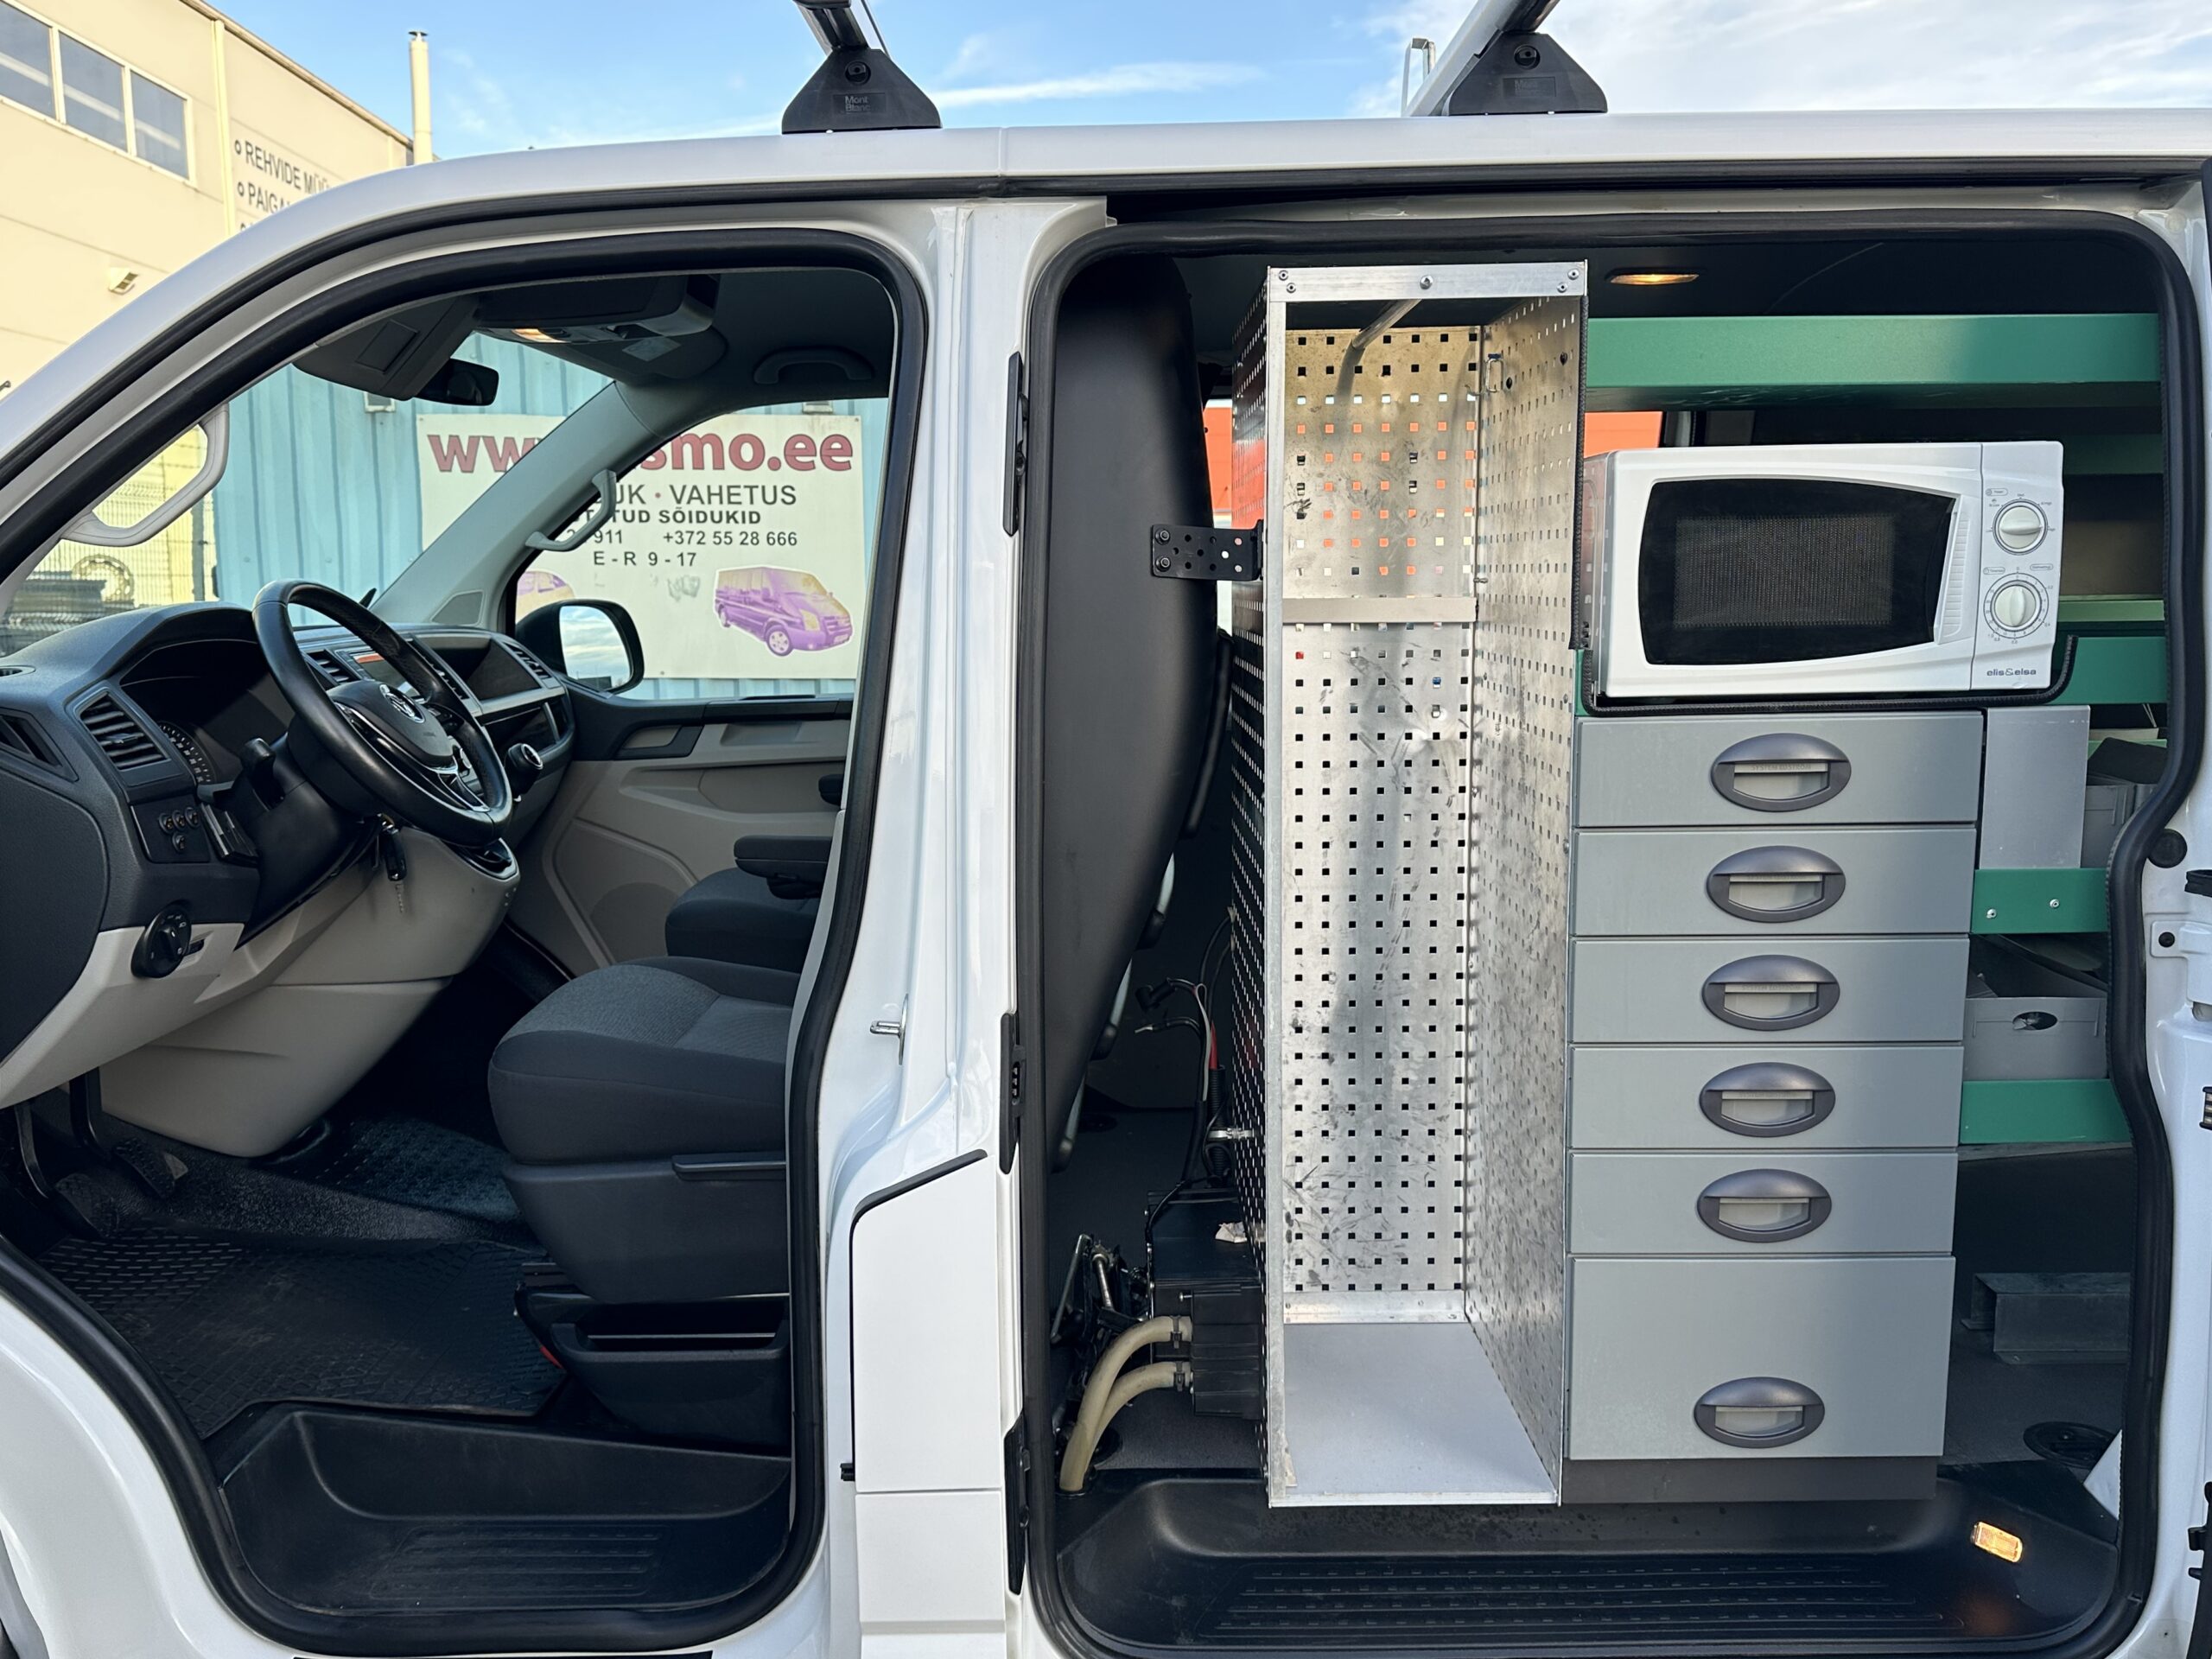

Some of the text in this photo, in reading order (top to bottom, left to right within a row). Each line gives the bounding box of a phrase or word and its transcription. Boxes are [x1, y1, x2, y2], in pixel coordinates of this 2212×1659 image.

[245, 140, 302, 190] REHVIDE
[669, 484, 797, 505] VAHETUS
[658, 506, 761, 524] SÕIDUKID
[663, 530, 707, 545] +372
[712, 531, 734, 546] 55
[740, 531, 760, 546] 28
[766, 531, 798, 546] 666
[594, 550, 605, 566] E
[624, 551, 637, 566] R
[648, 551, 658, 567] 9
[677, 552, 697, 567] 17
